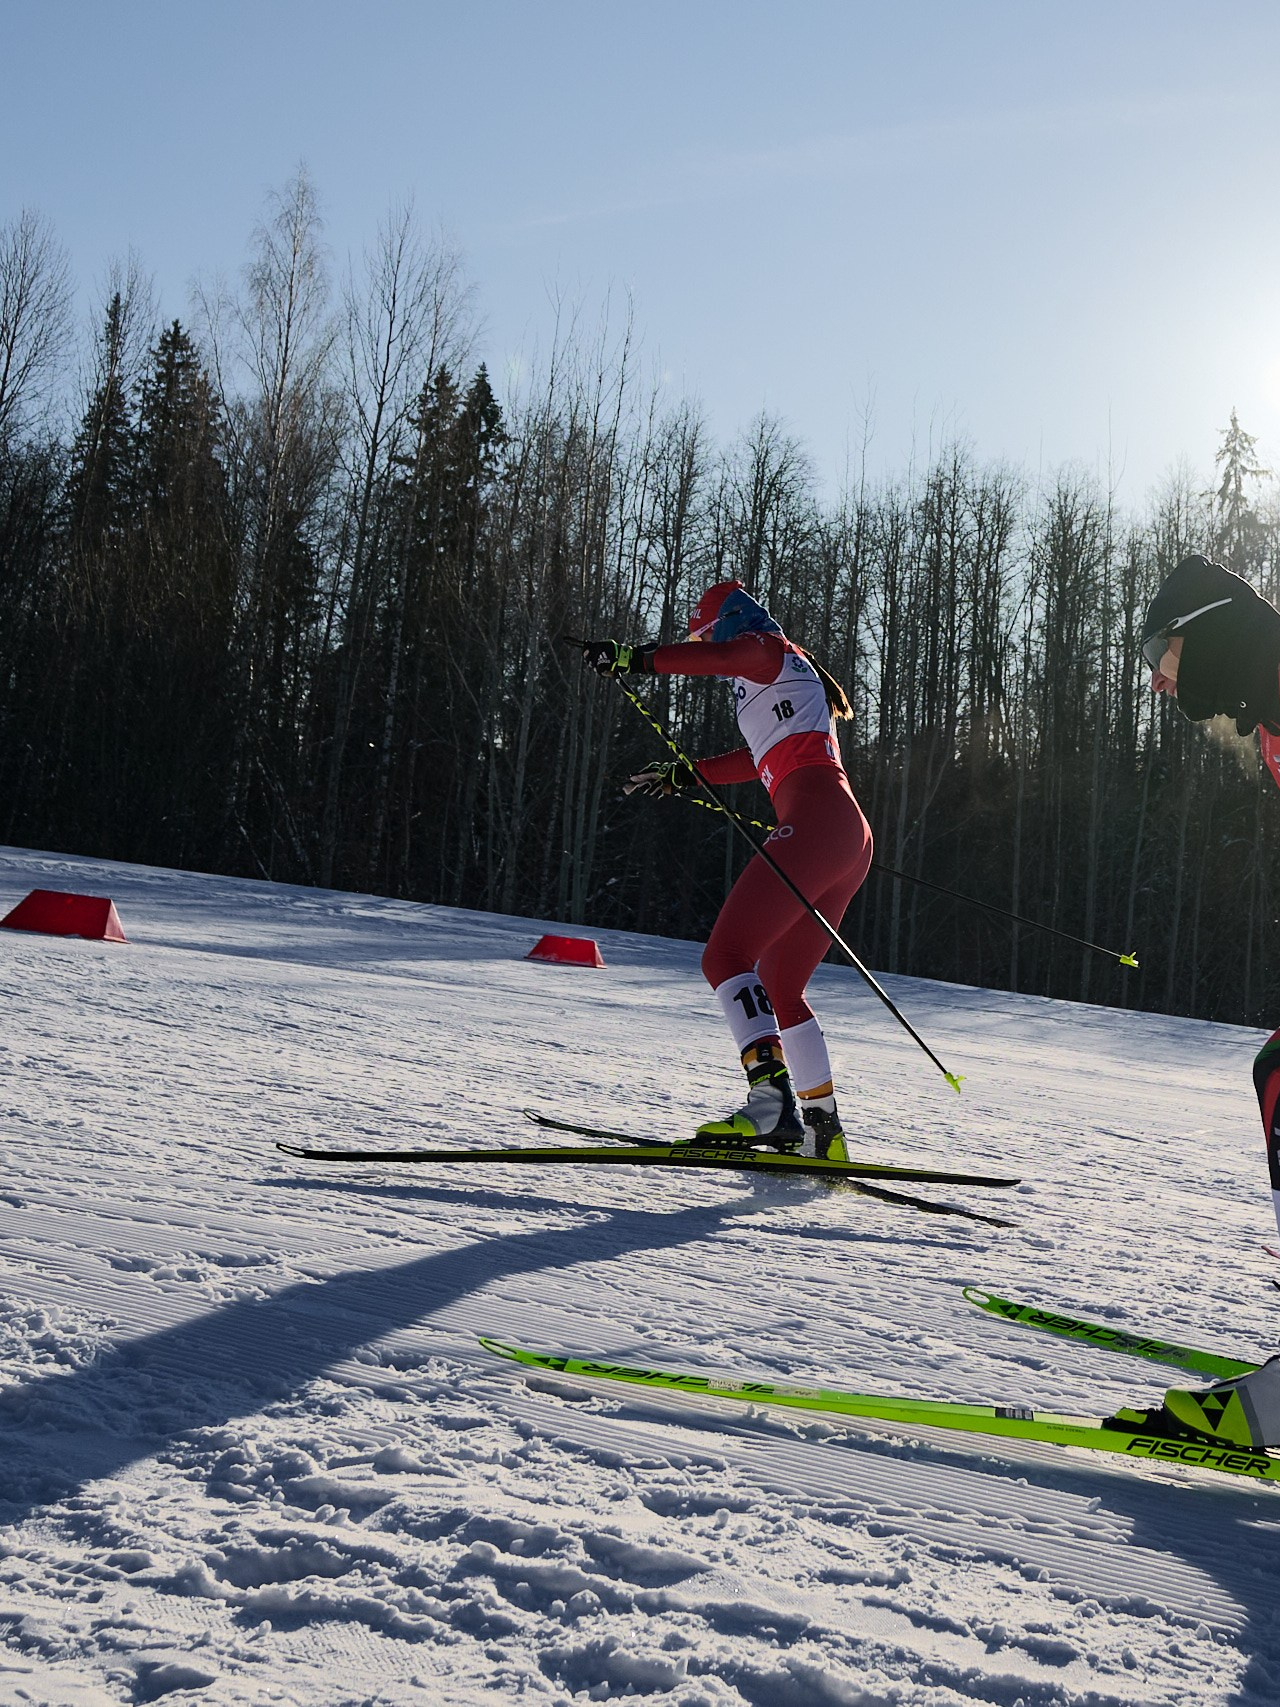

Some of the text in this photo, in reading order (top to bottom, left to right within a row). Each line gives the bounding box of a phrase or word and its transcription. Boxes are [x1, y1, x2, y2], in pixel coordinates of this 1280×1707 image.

[771, 699, 795, 723] 18
[733, 984, 775, 1020] 18
[669, 1148, 757, 1162] FISCHER
[1027, 1310, 1162, 1354] FICHER
[581, 1362, 774, 1395] FICHER
[1126, 1437, 1271, 1476] FISCHER
